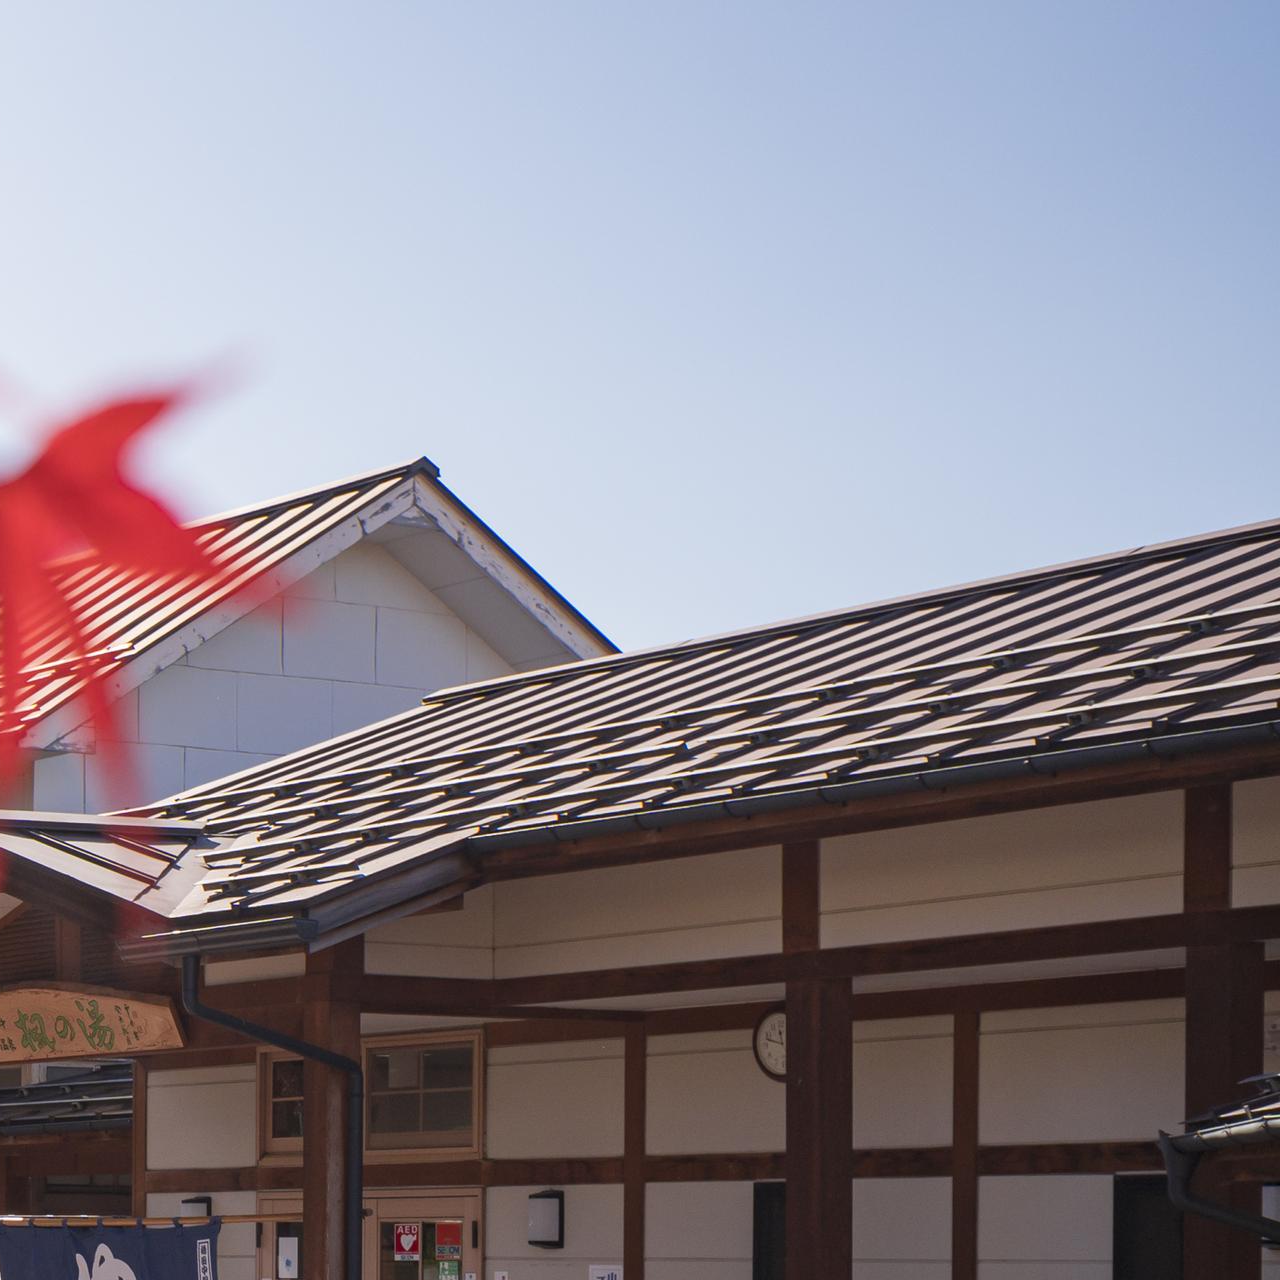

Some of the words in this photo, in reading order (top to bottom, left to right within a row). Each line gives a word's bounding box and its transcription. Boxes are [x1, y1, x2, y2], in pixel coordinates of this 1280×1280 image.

[14, 1000, 115, 1051] 楓の湯
[397, 1225, 418, 1234] AED
